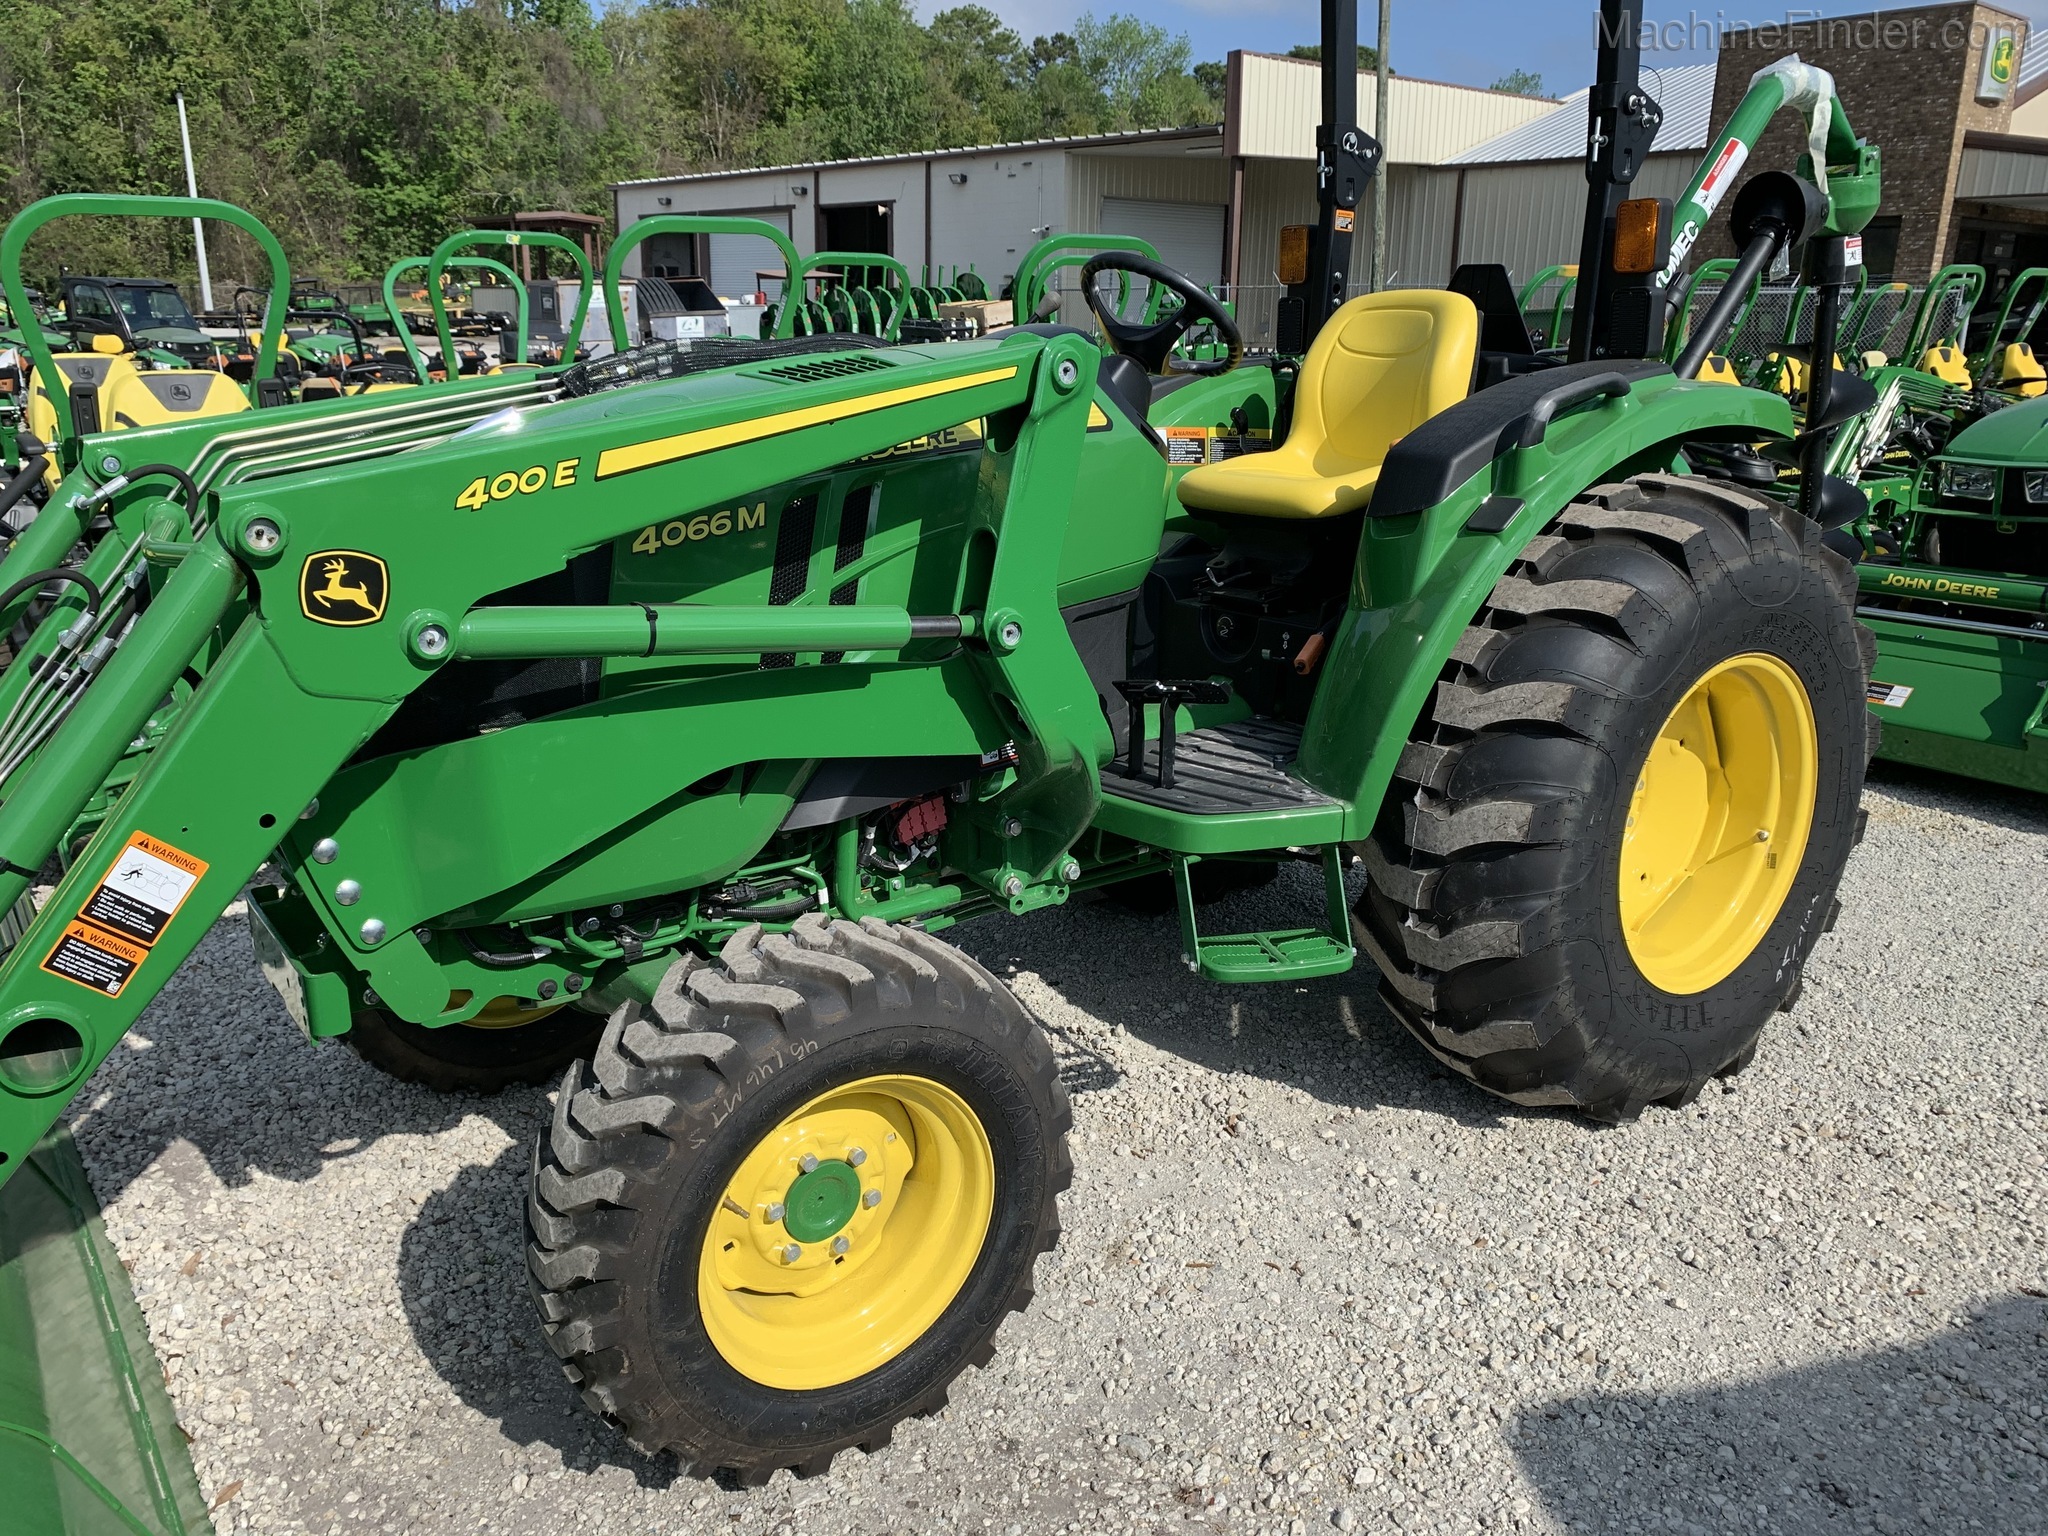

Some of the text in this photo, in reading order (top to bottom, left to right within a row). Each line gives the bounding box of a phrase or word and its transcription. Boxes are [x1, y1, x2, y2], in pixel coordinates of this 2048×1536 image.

[455, 457, 581, 511] 400 E
[632, 502, 767, 554] 4066 M
[1881, 573, 2000, 599] JOHN DEERE
[151, 843, 198, 872] WARNING
[89, 932, 138, 960] WARNING
[956, 1040, 1044, 1161] TITAN
